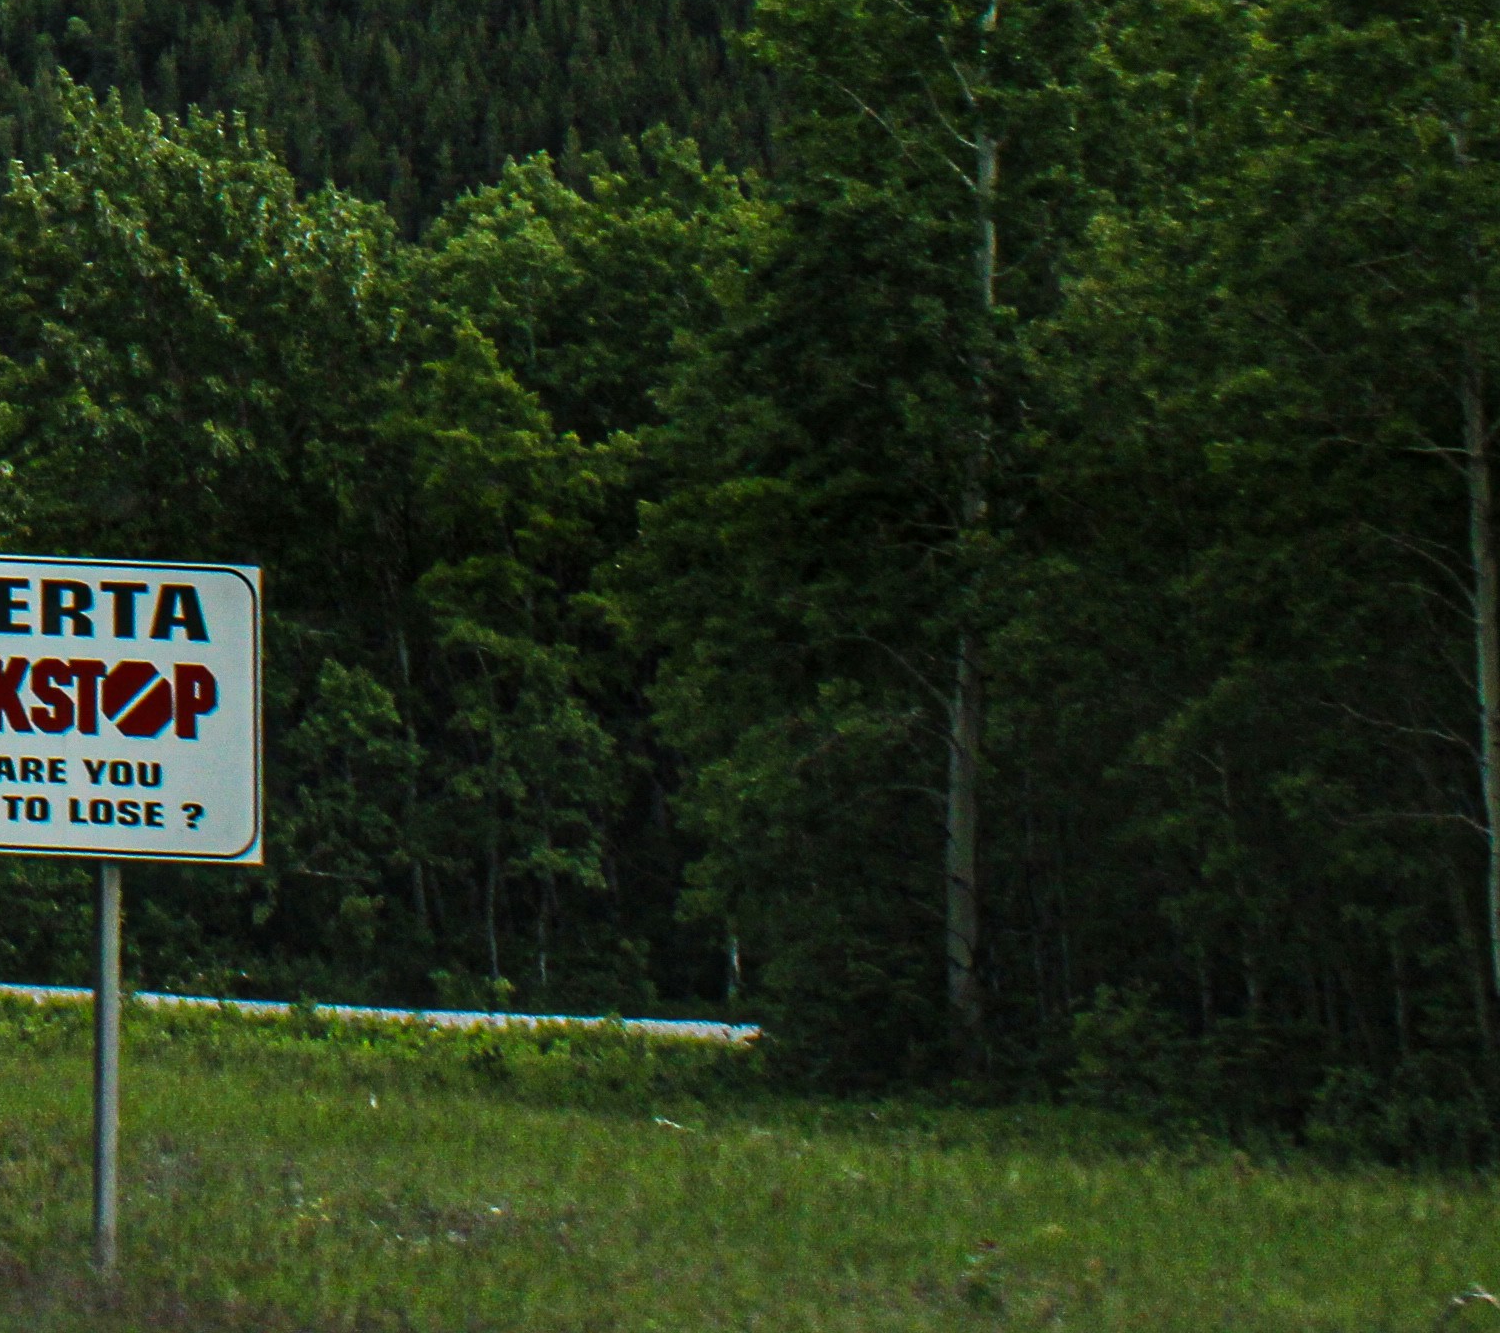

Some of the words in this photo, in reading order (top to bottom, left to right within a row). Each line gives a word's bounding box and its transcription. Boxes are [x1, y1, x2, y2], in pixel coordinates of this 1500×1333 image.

[83, 758, 164, 788] YOU
[2, 794, 52, 823] TO
[68, 796, 166, 829] LOSE
[181, 801, 205, 831] ?
